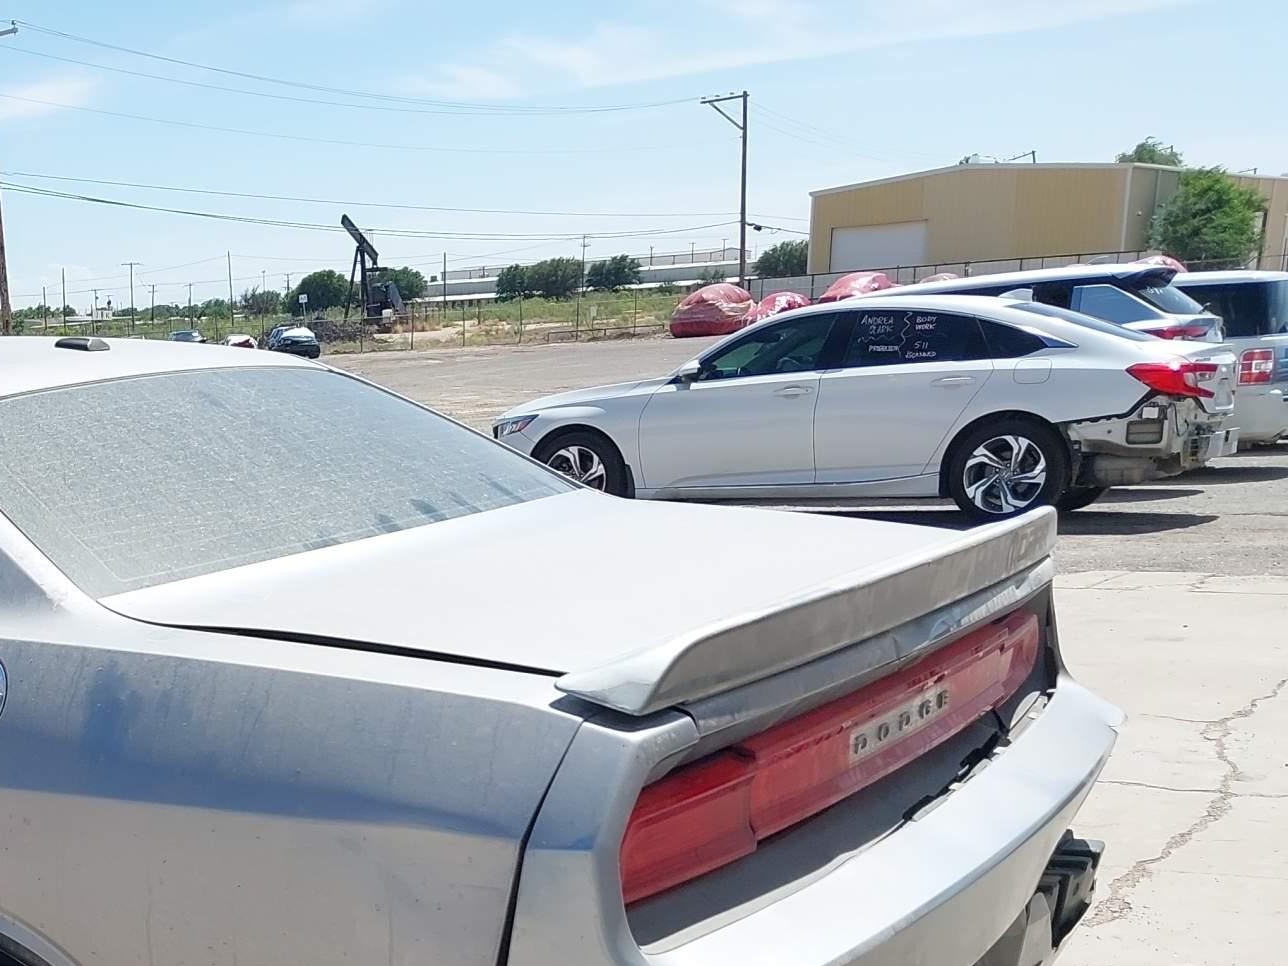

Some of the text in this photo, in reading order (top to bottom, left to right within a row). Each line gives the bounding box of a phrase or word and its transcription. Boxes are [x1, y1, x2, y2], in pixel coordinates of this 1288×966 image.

[915, 315, 938, 324] BODY
[915, 322, 937, 331] WORK
[854, 688, 951, 755] DODGE
